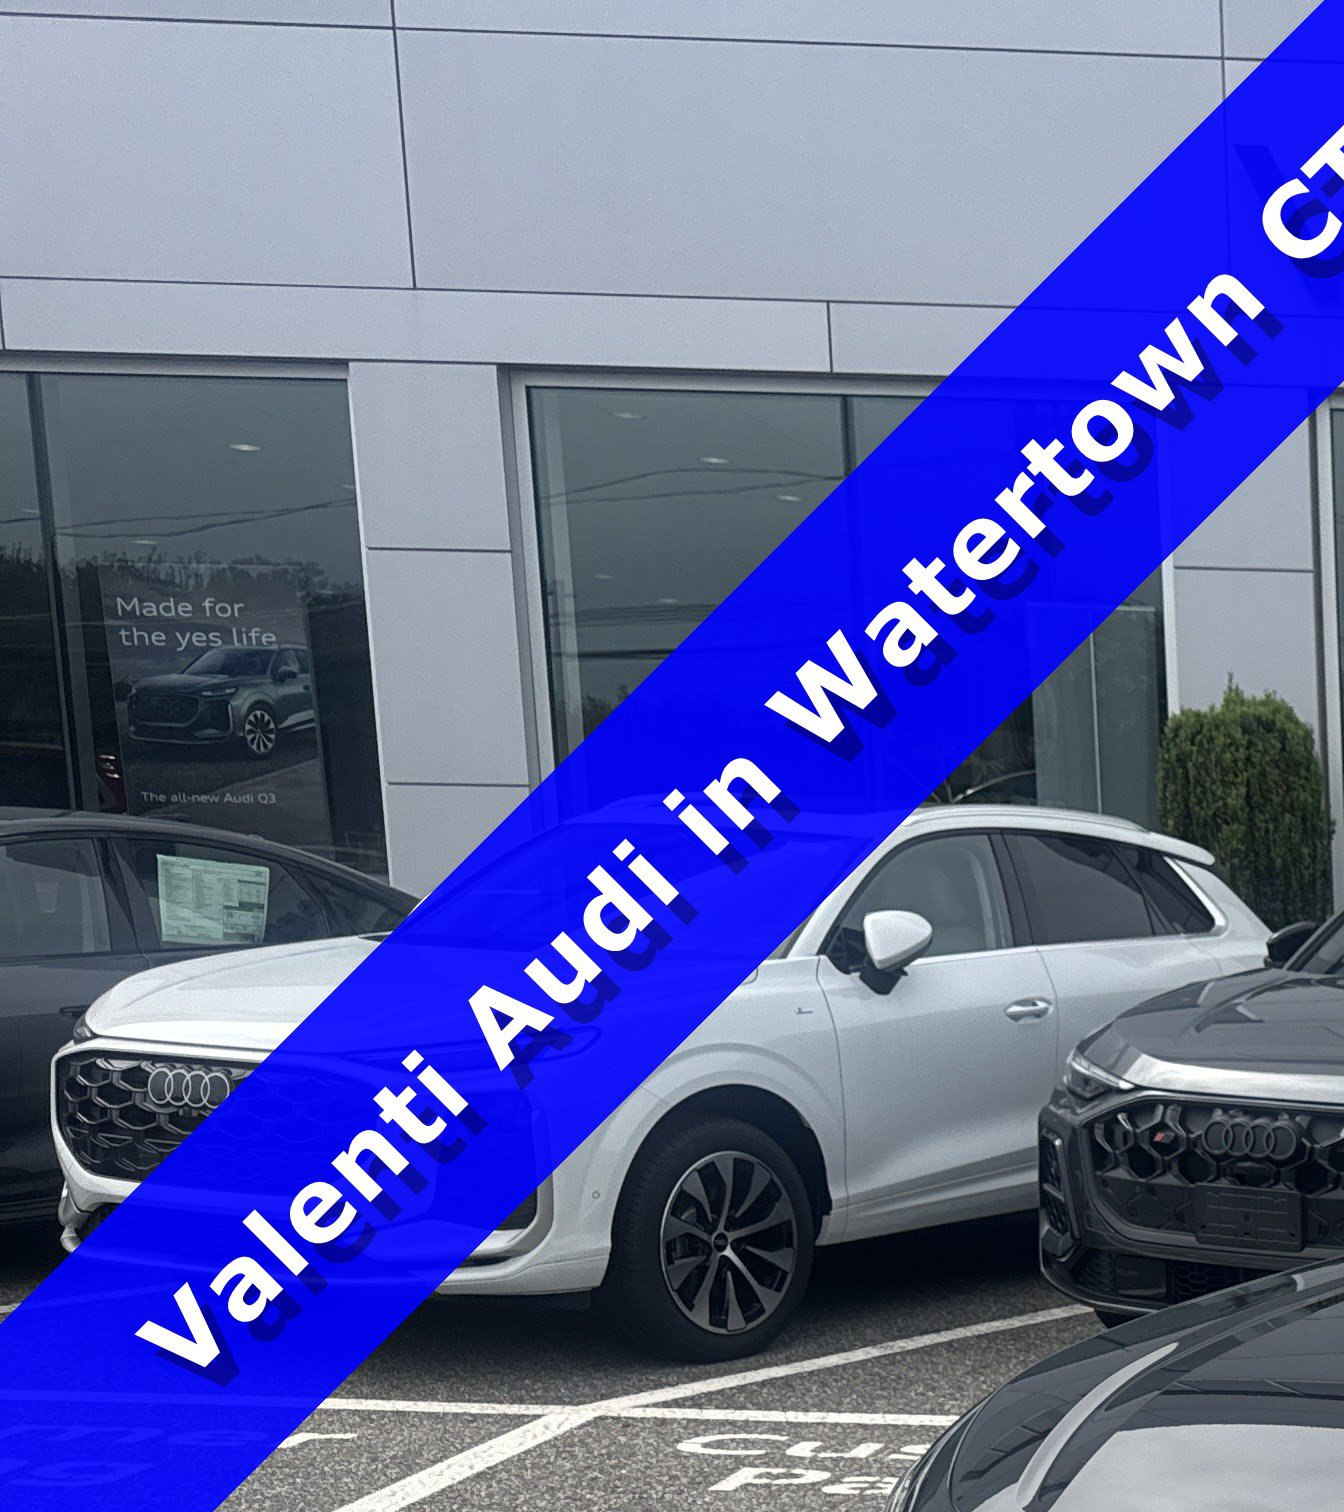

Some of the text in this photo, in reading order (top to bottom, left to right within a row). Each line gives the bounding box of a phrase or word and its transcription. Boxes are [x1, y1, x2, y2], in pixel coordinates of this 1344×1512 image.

[115, 597, 245, 618] Made for
[119, 627, 277, 652] the yes life
[140, 791, 277, 805] The all-new Audi Q3
[676, 1433, 930, 1459] Cus
[708, 1467, 900, 1495] Pa
